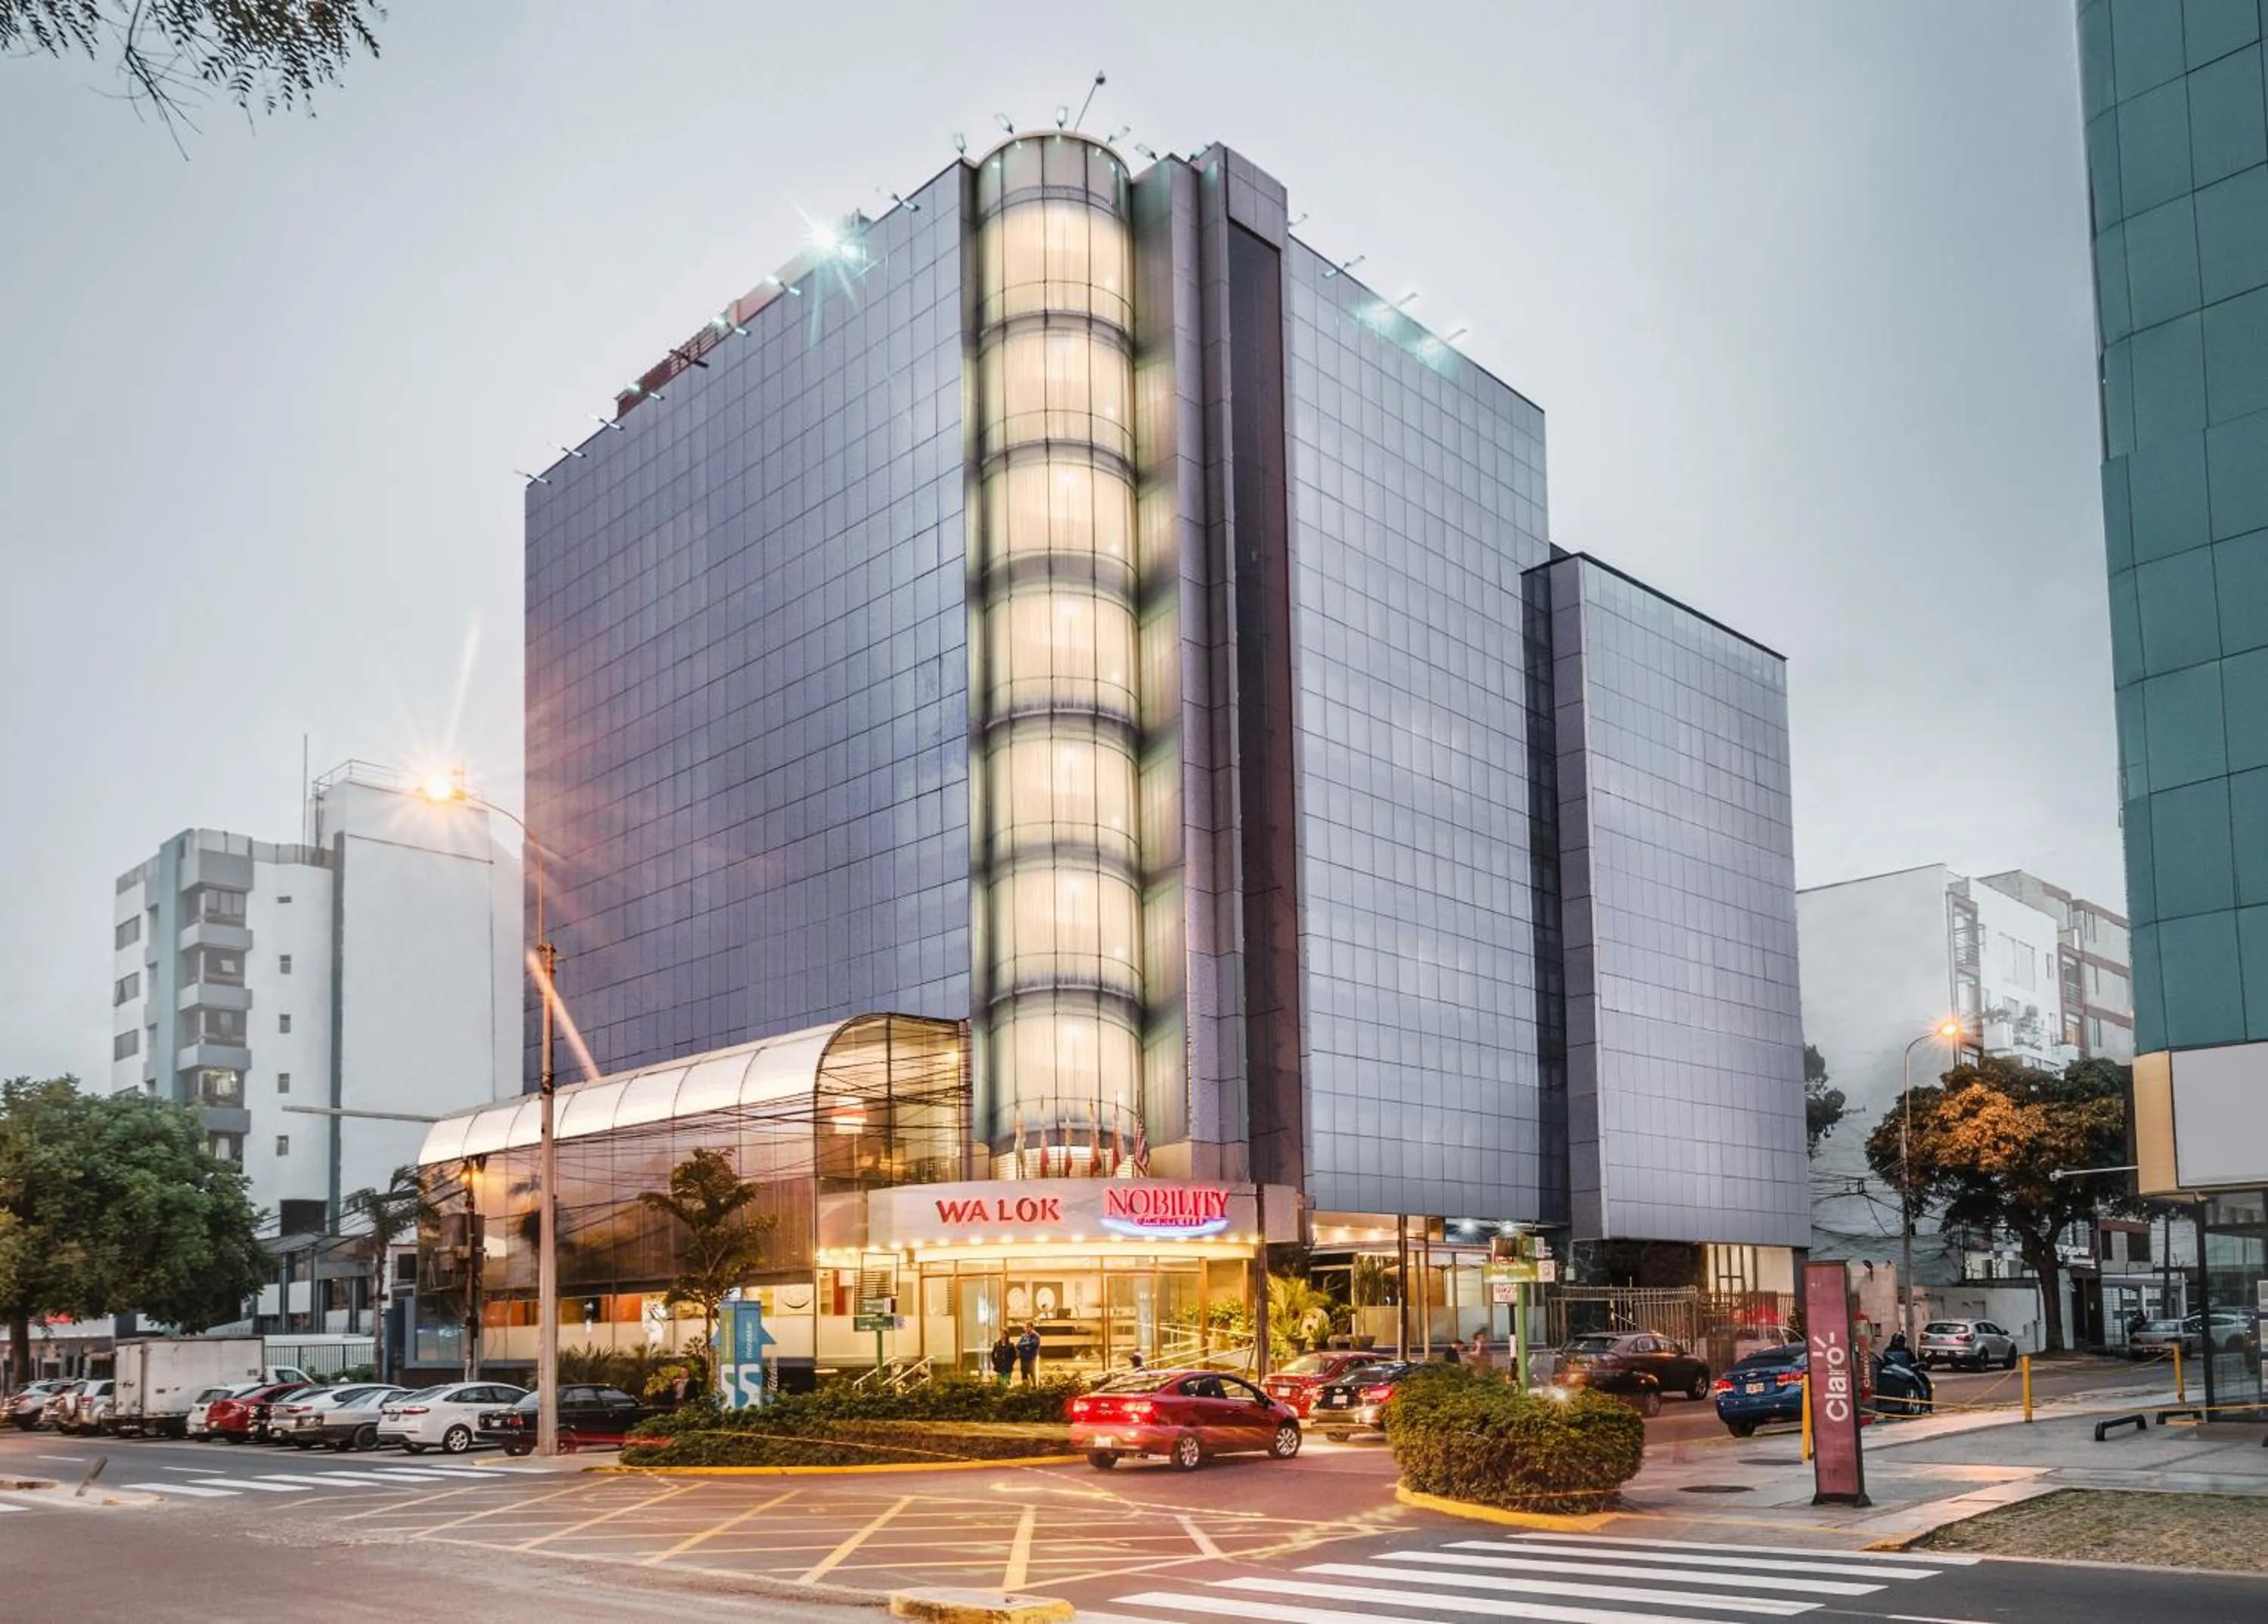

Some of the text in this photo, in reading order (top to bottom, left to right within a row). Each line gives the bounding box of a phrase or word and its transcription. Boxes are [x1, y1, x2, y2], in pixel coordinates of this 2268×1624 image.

[934, 1197, 1061, 1223] WA LOK
[1107, 1188, 1230, 1218] NOBILITY
[1824, 1346, 1849, 1422] Claro
